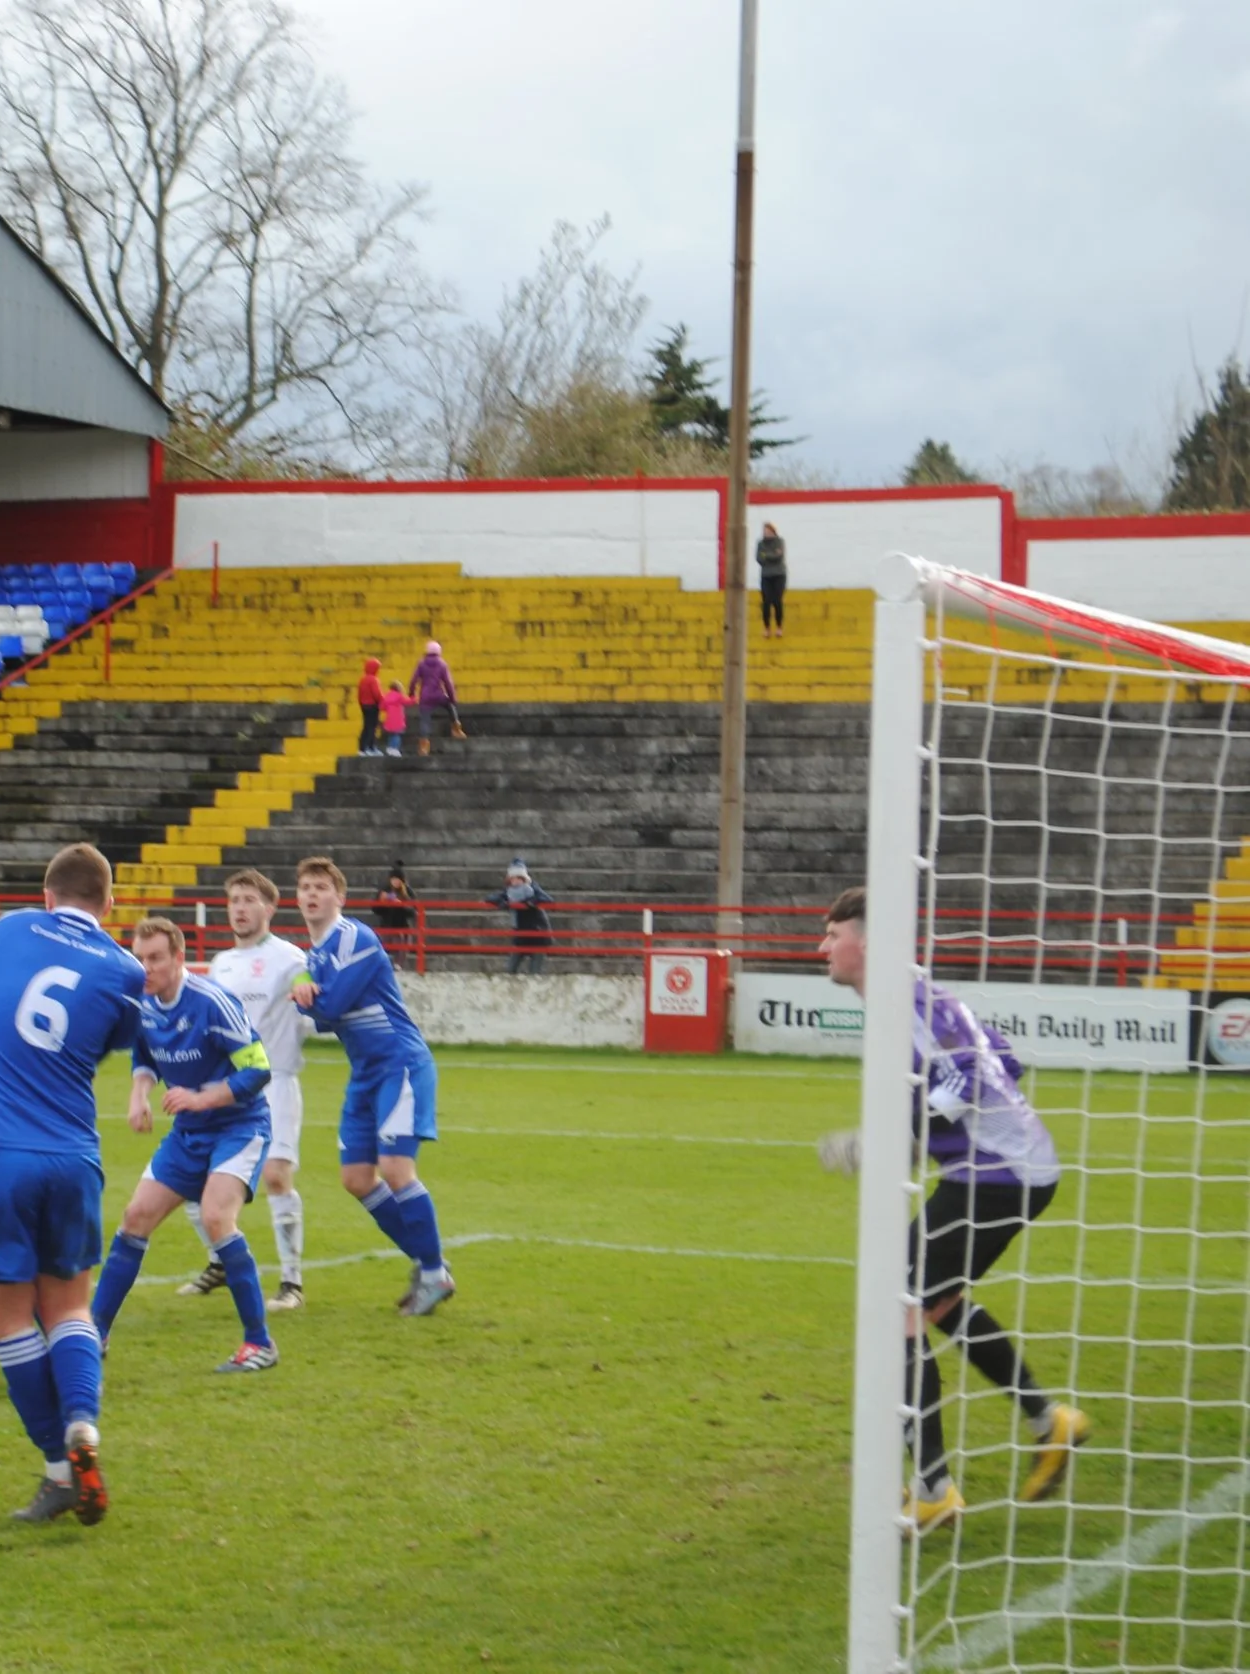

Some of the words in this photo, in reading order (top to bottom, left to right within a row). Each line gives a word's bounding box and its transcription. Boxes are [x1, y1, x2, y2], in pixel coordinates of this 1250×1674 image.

[14, 965, 82, 1053] 6
[758, 999, 821, 1028] The
[972, 1011, 1028, 1037] rish
[1037, 1014, 1106, 1048] Daily
[1114, 1016, 1178, 1044] Mail
